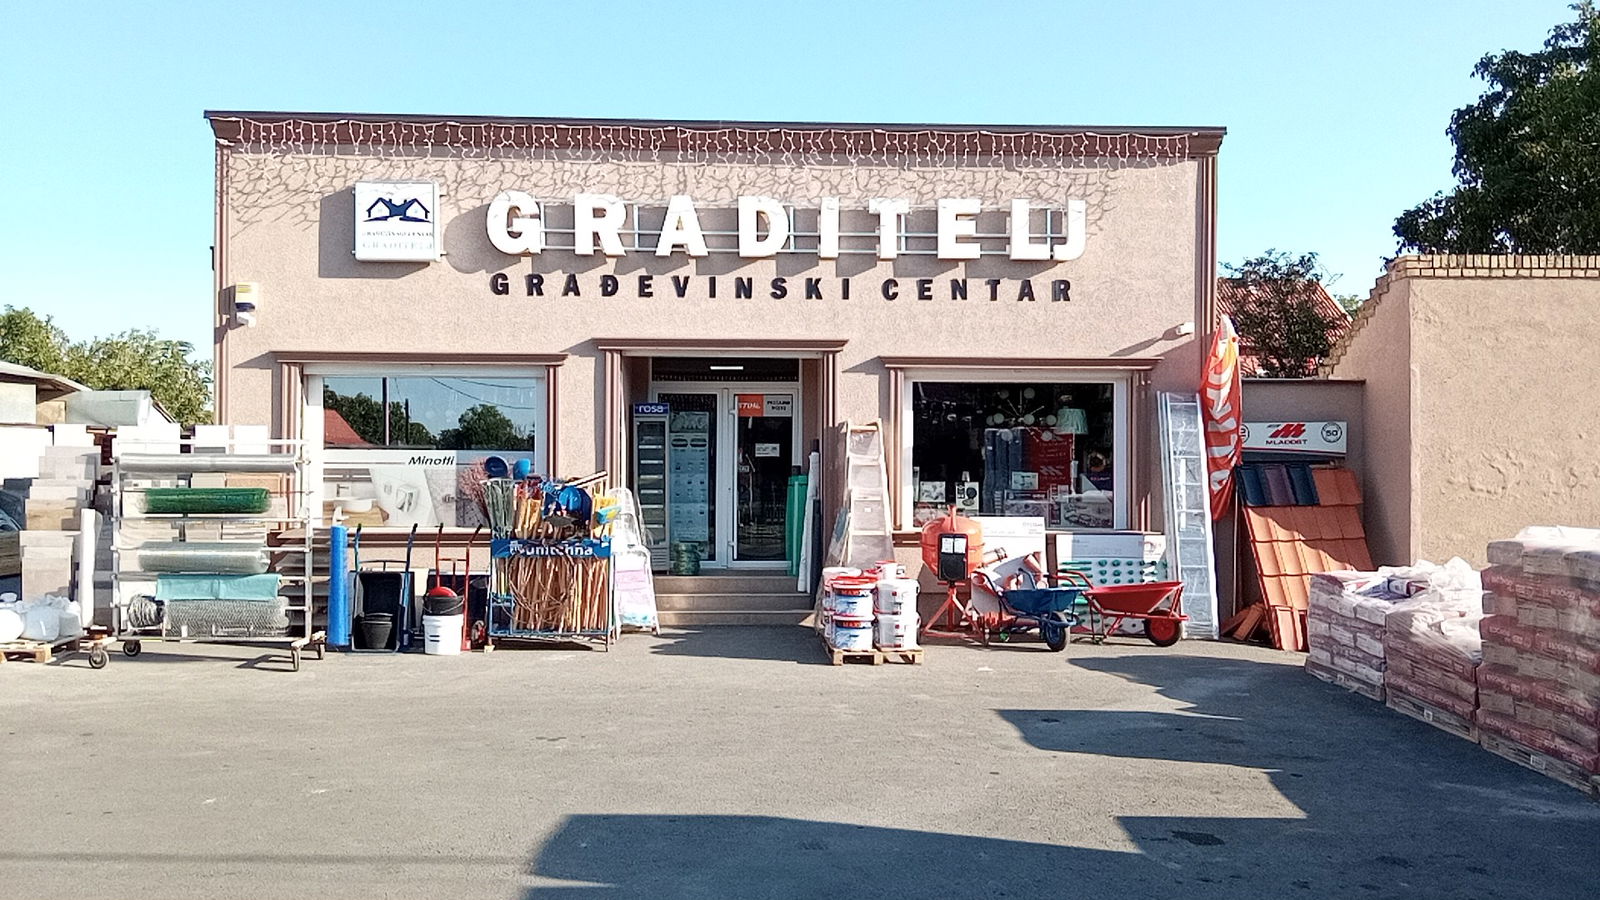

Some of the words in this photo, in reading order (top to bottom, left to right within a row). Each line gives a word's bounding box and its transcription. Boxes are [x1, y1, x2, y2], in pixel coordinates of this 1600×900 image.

[486, 190, 1086, 261] GRADITELJ
[489, 272, 850, 300] GRAĐEVINSKI
[881, 278, 1071, 302] CENTAR
[638, 404, 664, 413] rosa
[407, 455, 455, 466] Minotti
